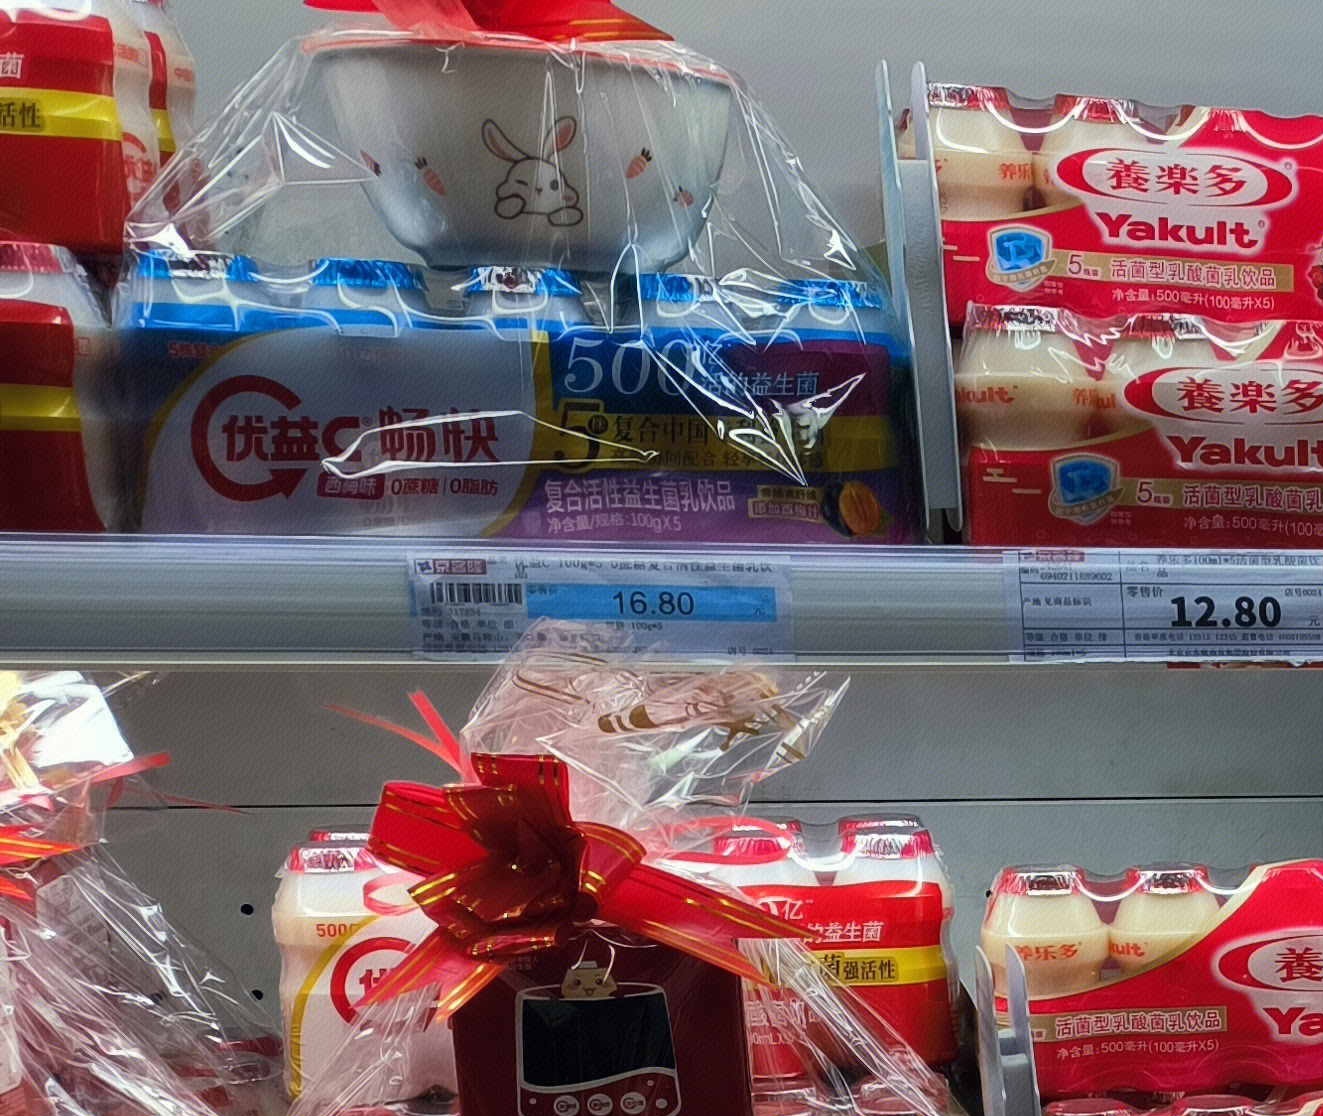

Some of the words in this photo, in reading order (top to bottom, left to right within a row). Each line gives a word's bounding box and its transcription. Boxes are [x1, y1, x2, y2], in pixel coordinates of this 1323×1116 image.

[1095, 212, 1258, 248] Yakult
[1111, 259, 1275, 288] 活菌型乳酸菌乳饮品
[450, 478, 498, 496] 0脂肪
[544, 480, 734, 512] 复合活性益生菌乳饮品
[612, 589, 695, 617] 16.80
[1126, 586, 1163, 598] 零售价
[1170, 595, 1282, 628] 12.80
[844, 958, 897, 983] 强活性
[1055, 1011, 1222, 1040] 活菌型乳酸菌乳饮品
